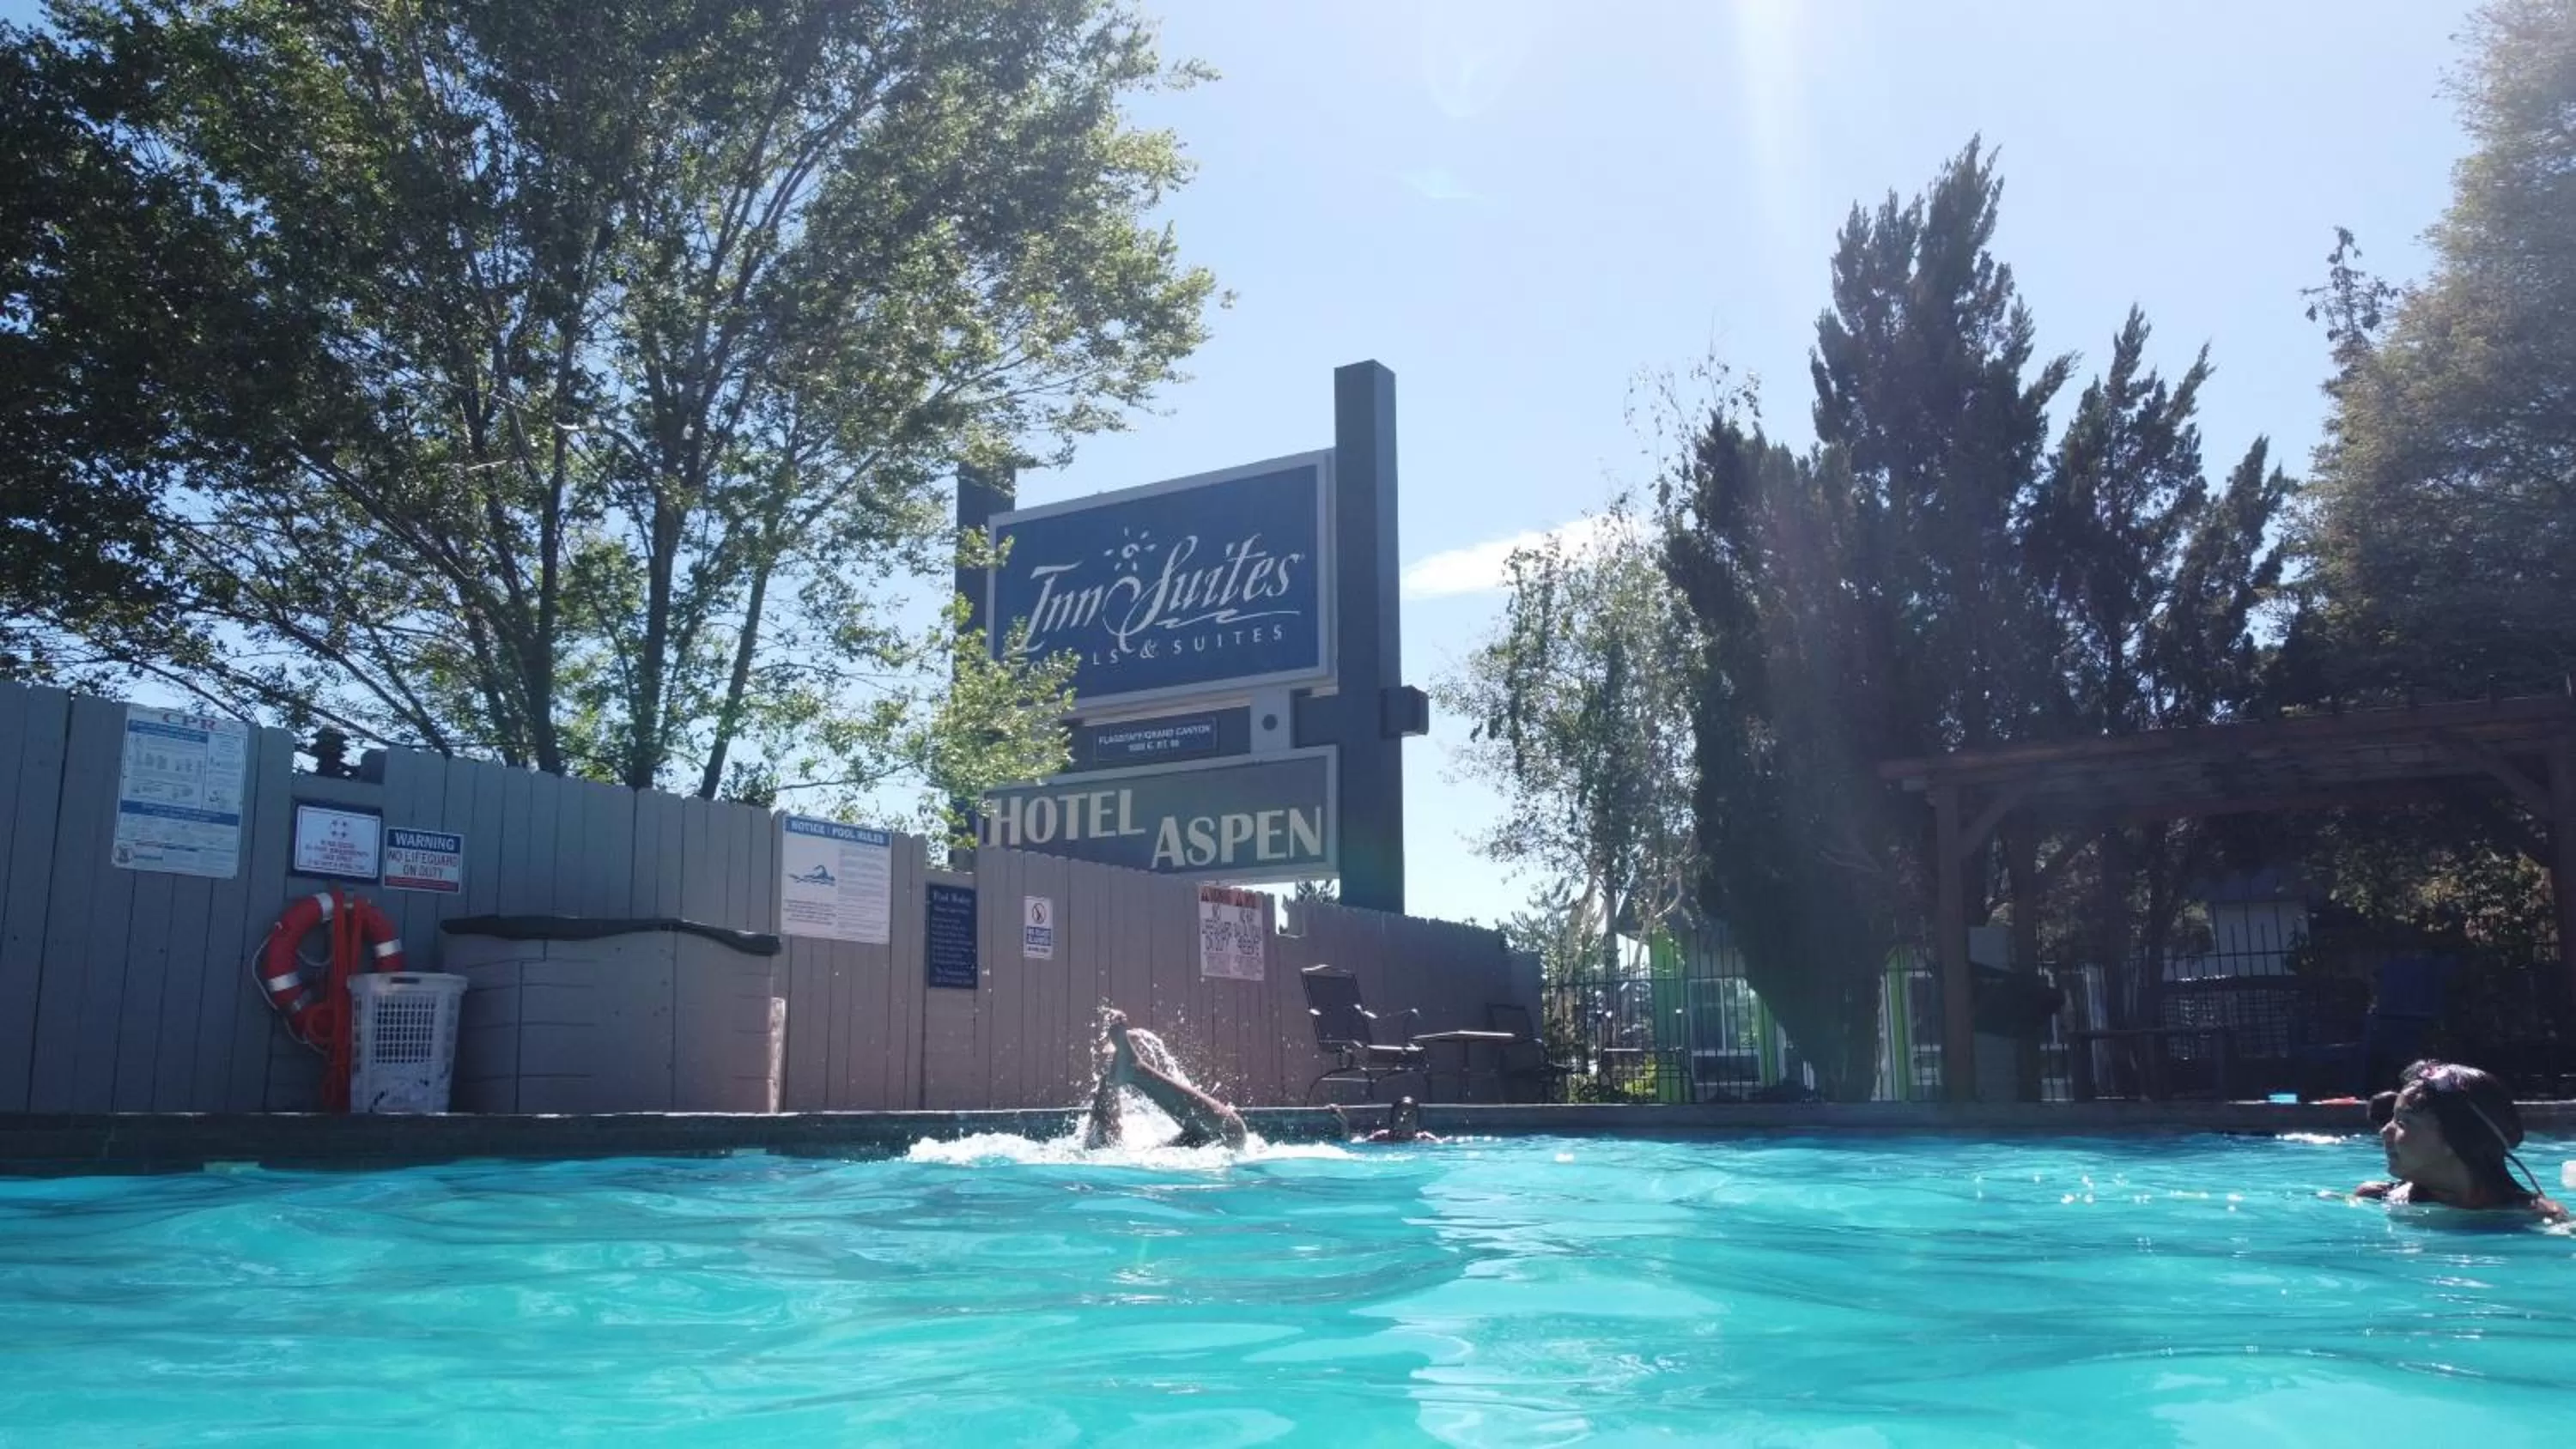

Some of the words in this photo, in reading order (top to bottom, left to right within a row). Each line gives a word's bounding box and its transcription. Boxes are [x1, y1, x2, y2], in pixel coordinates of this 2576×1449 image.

[1139, 638, 1157, 659] &
[1173, 624, 1283, 655] SUITES
[161, 712, 216, 731] CPR
[1176, 724, 1211, 736] CANYON
[833, 827, 855, 839] POOL
[859, 830, 884, 844] RULES
[989, 788, 1145, 846] HOTEL
[1150, 806, 1322, 870] ASPEN
[395, 831, 455, 851] WARNING
[387, 850, 403, 862] NO
[403, 864, 416, 876] ON
[418, 866, 443, 878] DUTY
